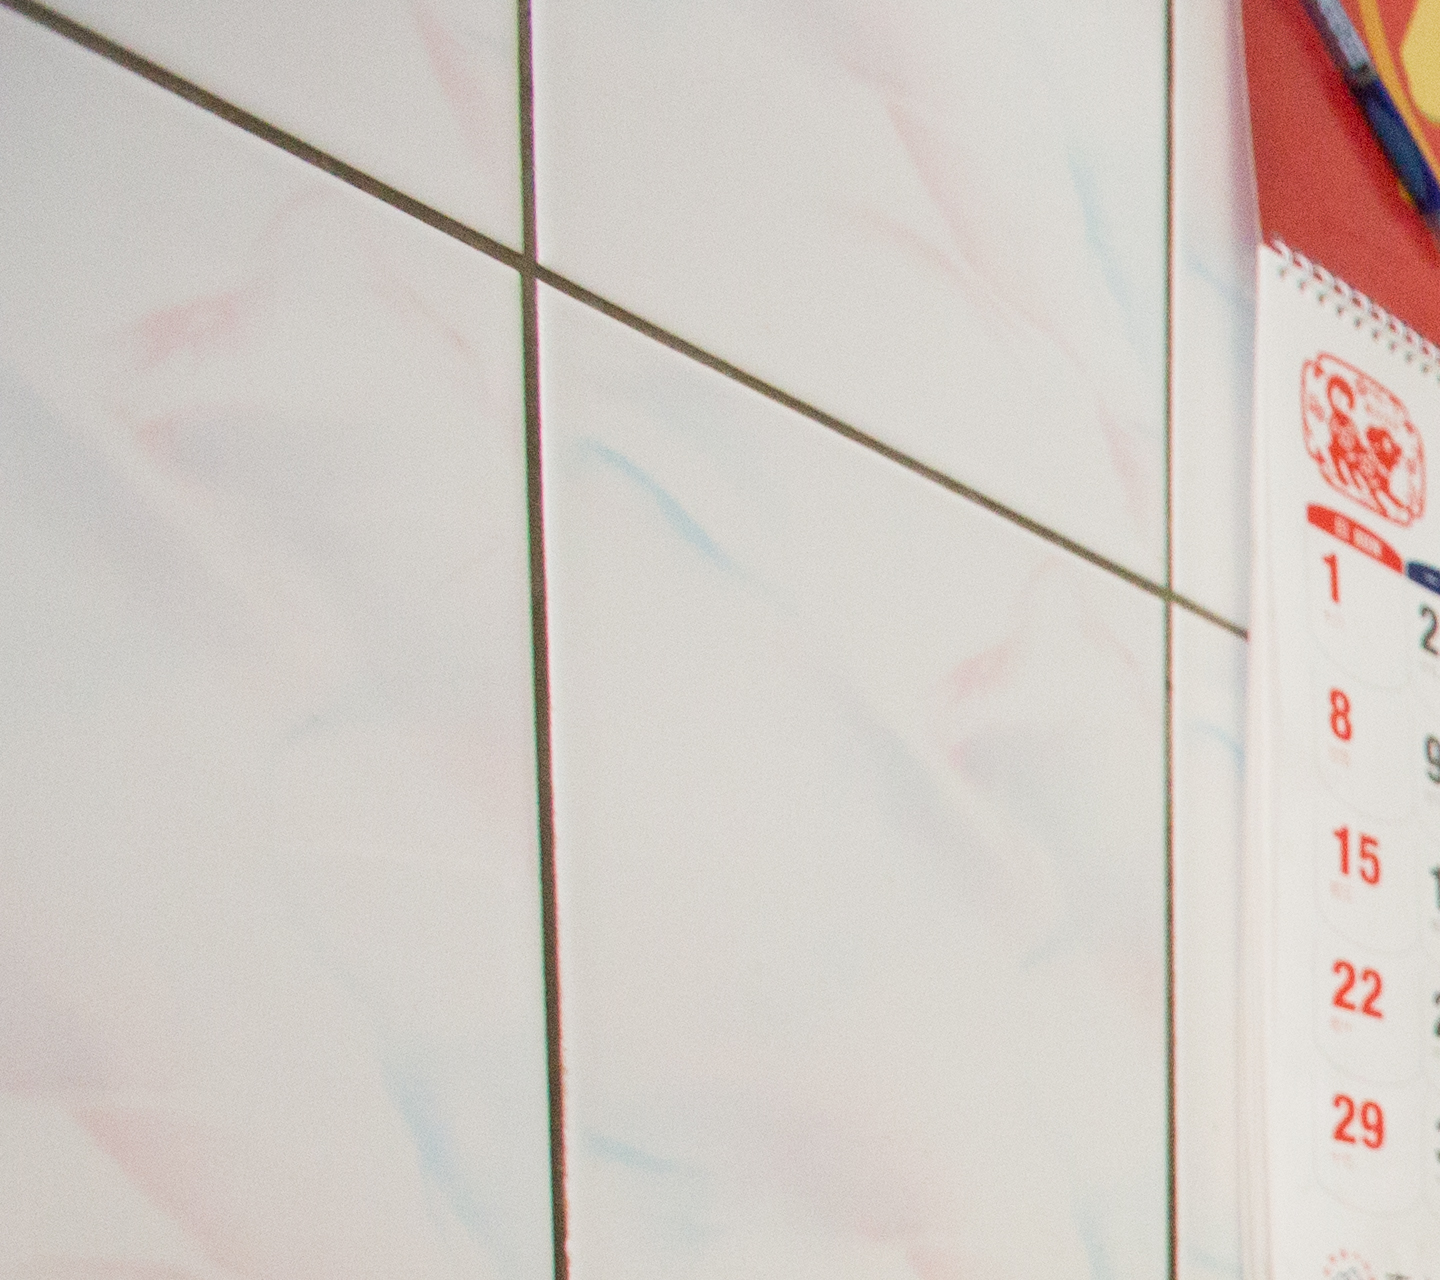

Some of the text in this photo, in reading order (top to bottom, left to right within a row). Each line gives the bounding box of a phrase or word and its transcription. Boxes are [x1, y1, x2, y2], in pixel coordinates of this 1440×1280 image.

[1323, 554, 1339, 603] 1
[1419, 605, 1439, 656] 2
[1330, 689, 1352, 741] 8
[1334, 827, 1381, 885] 15
[1333, 960, 1383, 1019] 22
[1333, 1094, 1385, 1149] 29
